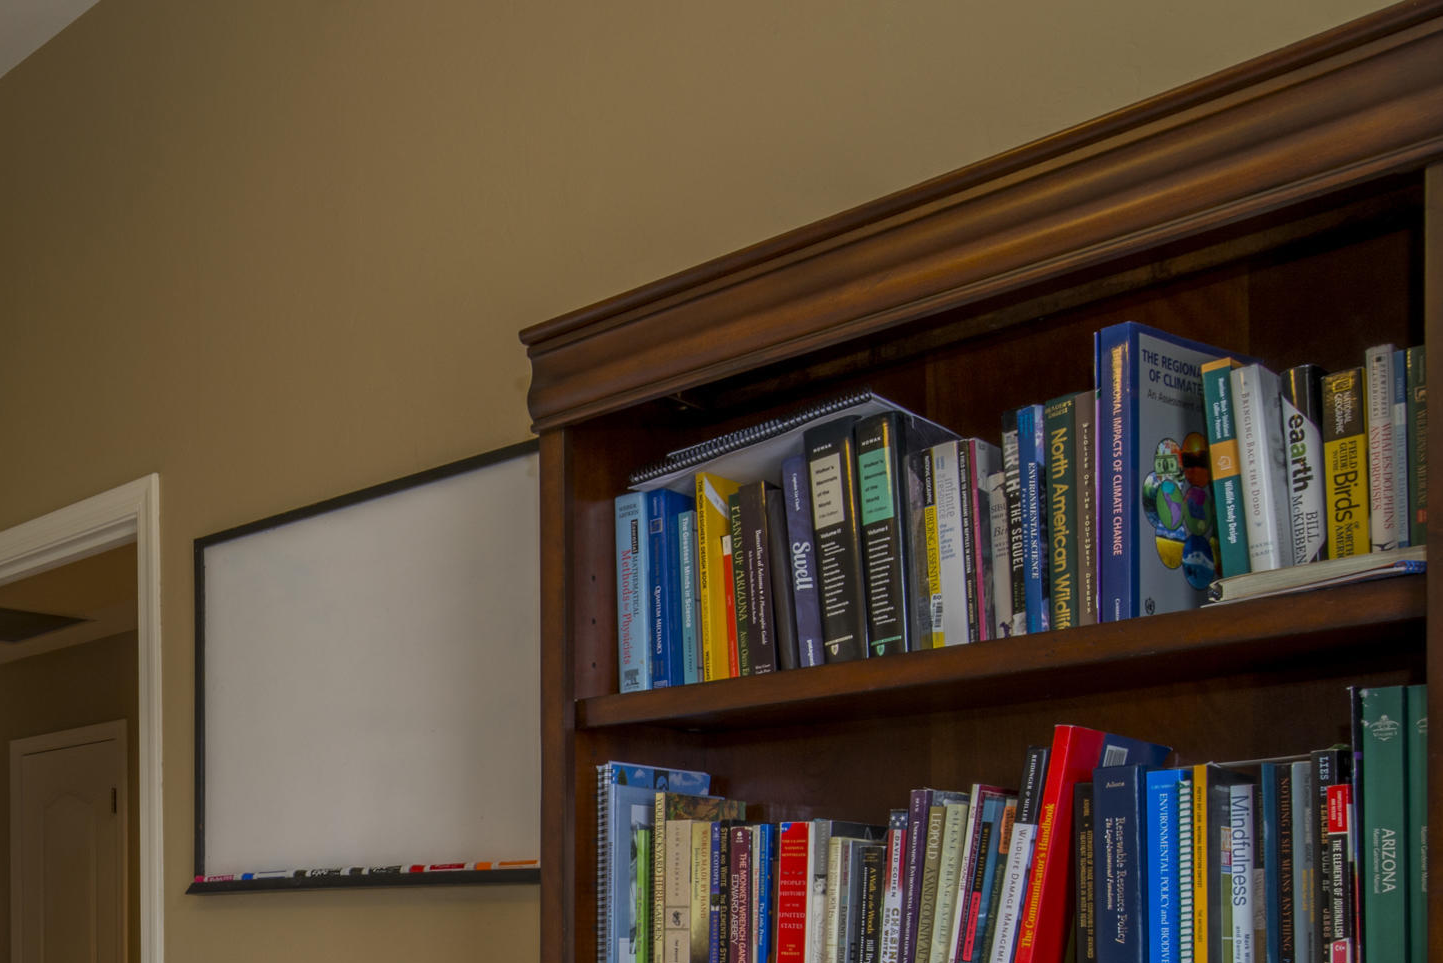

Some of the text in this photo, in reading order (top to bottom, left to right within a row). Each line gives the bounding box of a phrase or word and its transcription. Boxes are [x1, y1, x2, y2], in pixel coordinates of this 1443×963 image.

[1050, 427, 1069, 480] North
[1112, 416, 1123, 458] IMPACTS
[1287, 413, 1315, 494] eaarth
[1347, 439, 1358, 470] FIELD
[1112, 459, 1123, 472] OF
[1112, 474, 1123, 515] CLIMATE
[1223, 480, 1237, 544] Wildlife Study Design
[1333, 471, 1361, 523] Birds
[1026, 462, 1041, 580] ENVIRONMENTAL SCIENCE
[1052, 483, 1070, 574] American
[1112, 516, 1123, 556] CHANGE
[1292, 493, 1307, 565] McKIBBEN
[1305, 511, 1320, 544] BILL
[620, 549, 632, 602] Methods
[680, 516, 693, 628] The Greatest Minds in Science
[792, 541, 814, 591] Swell
[621, 611, 632, 665] Physicists
[1280, 776, 1290, 829] NOTHING
[892, 834, 900, 864] DAVID
[927, 812, 943, 861] LEOPOLD
[1012, 828, 1028, 871] WILDLIFE
[1230, 795, 1251, 907] Mindfulness
[1280, 837, 1290, 856] SEE
[1380, 828, 1397, 893] ARIZONA
[712, 850, 720, 885] ECOTOPIA
[1006, 872, 1020, 908] DAMAGE
[1020, 803, 1056, 950] The Communicator's Handbook
[1280, 858, 1291, 895] MEANS
[730, 874, 740, 946] EDWARD ABBEY
[1280, 897, 1292, 951] ANYTHING
